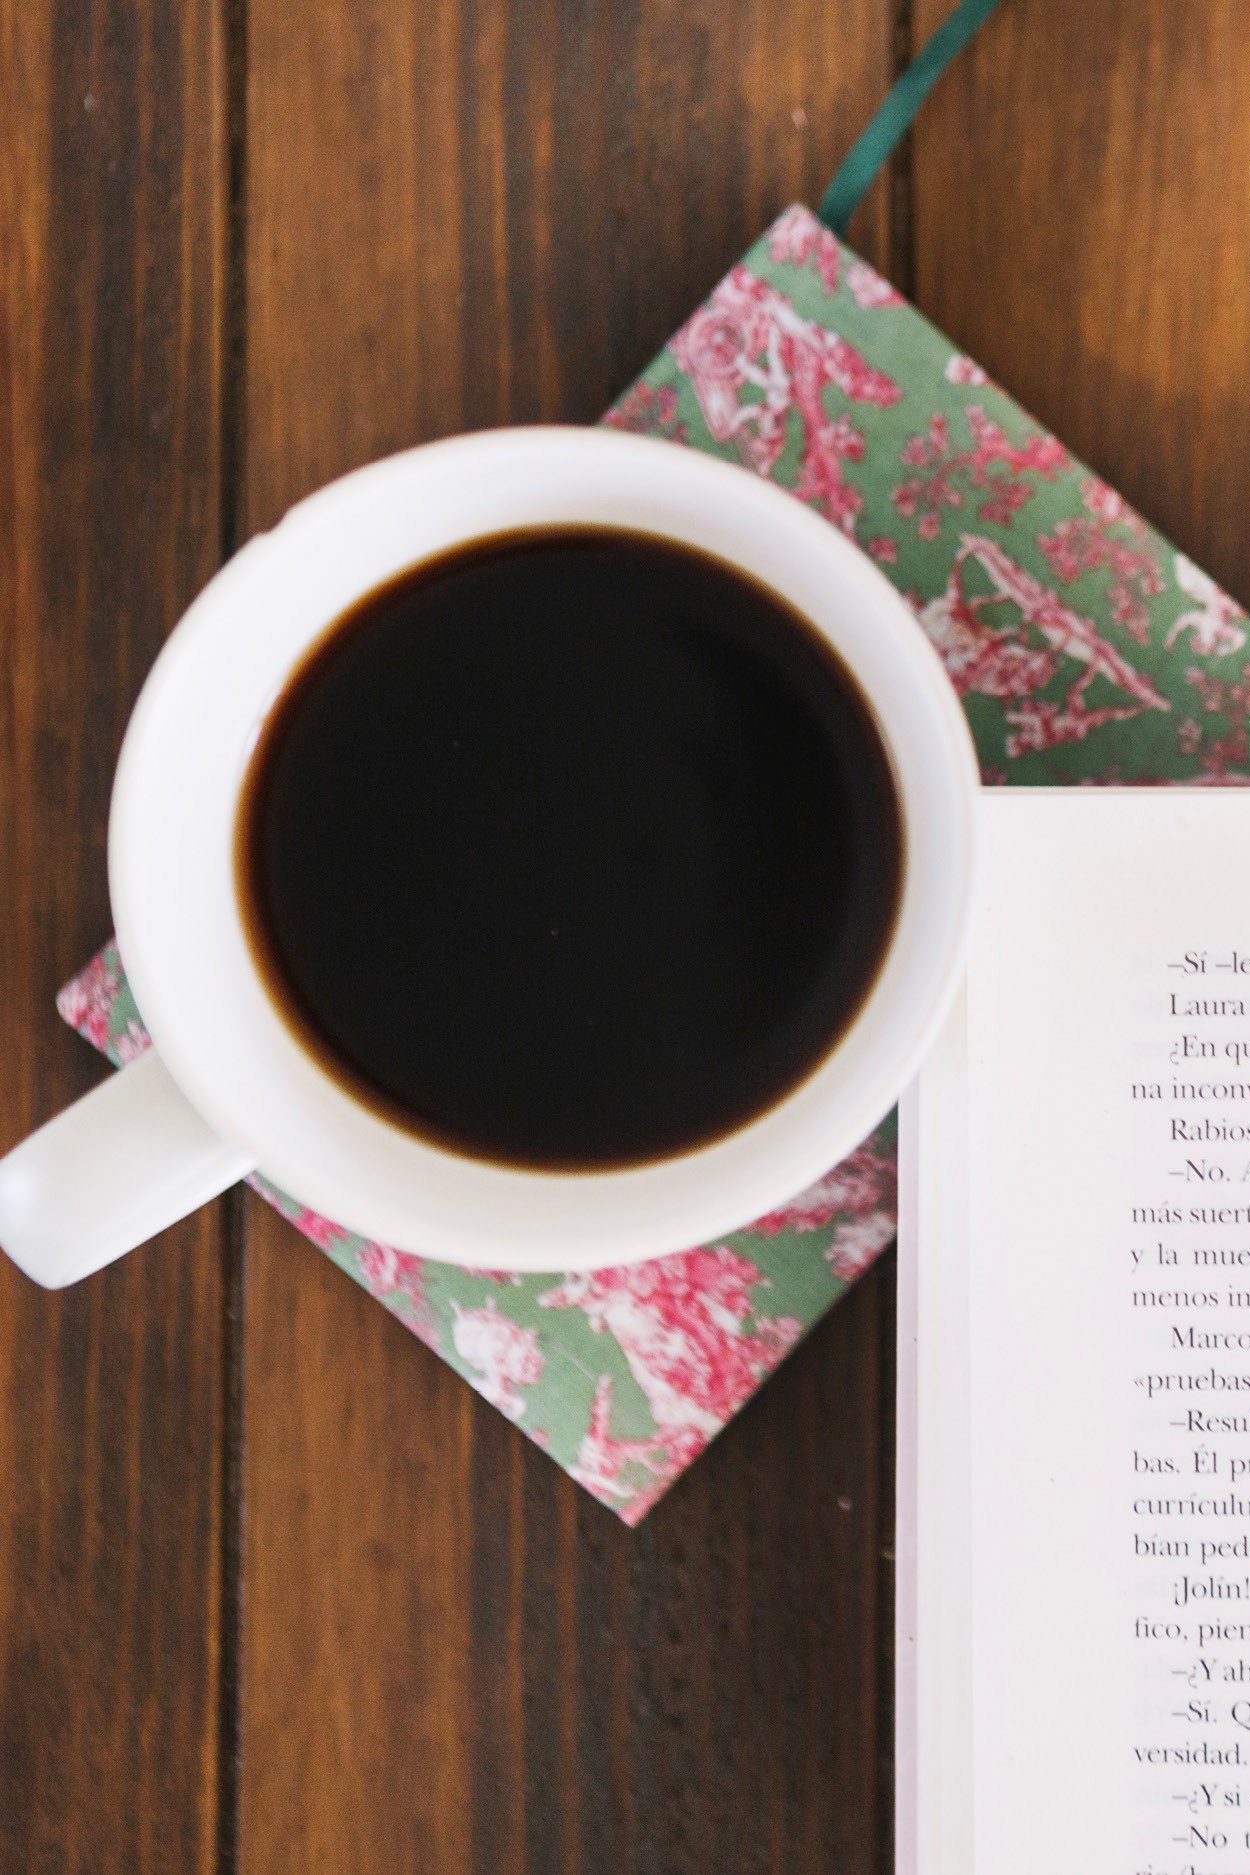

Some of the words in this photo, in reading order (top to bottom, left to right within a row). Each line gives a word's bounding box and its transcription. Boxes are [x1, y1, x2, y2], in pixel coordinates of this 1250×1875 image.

[1169, 992, 1247, 1017] Laura
[1169, 1034, 1217, 1066] ¿En
[1131, 1082, 1163, 1100] na
[1132, 1290, 1219, 1308] menos
[1133, 1532, 1190, 1558] bían
[1134, 1616, 1188, 1641] fico,
[1133, 1741, 1248, 1766] versidad.
[1223, 1784, 1241, 1808] si
